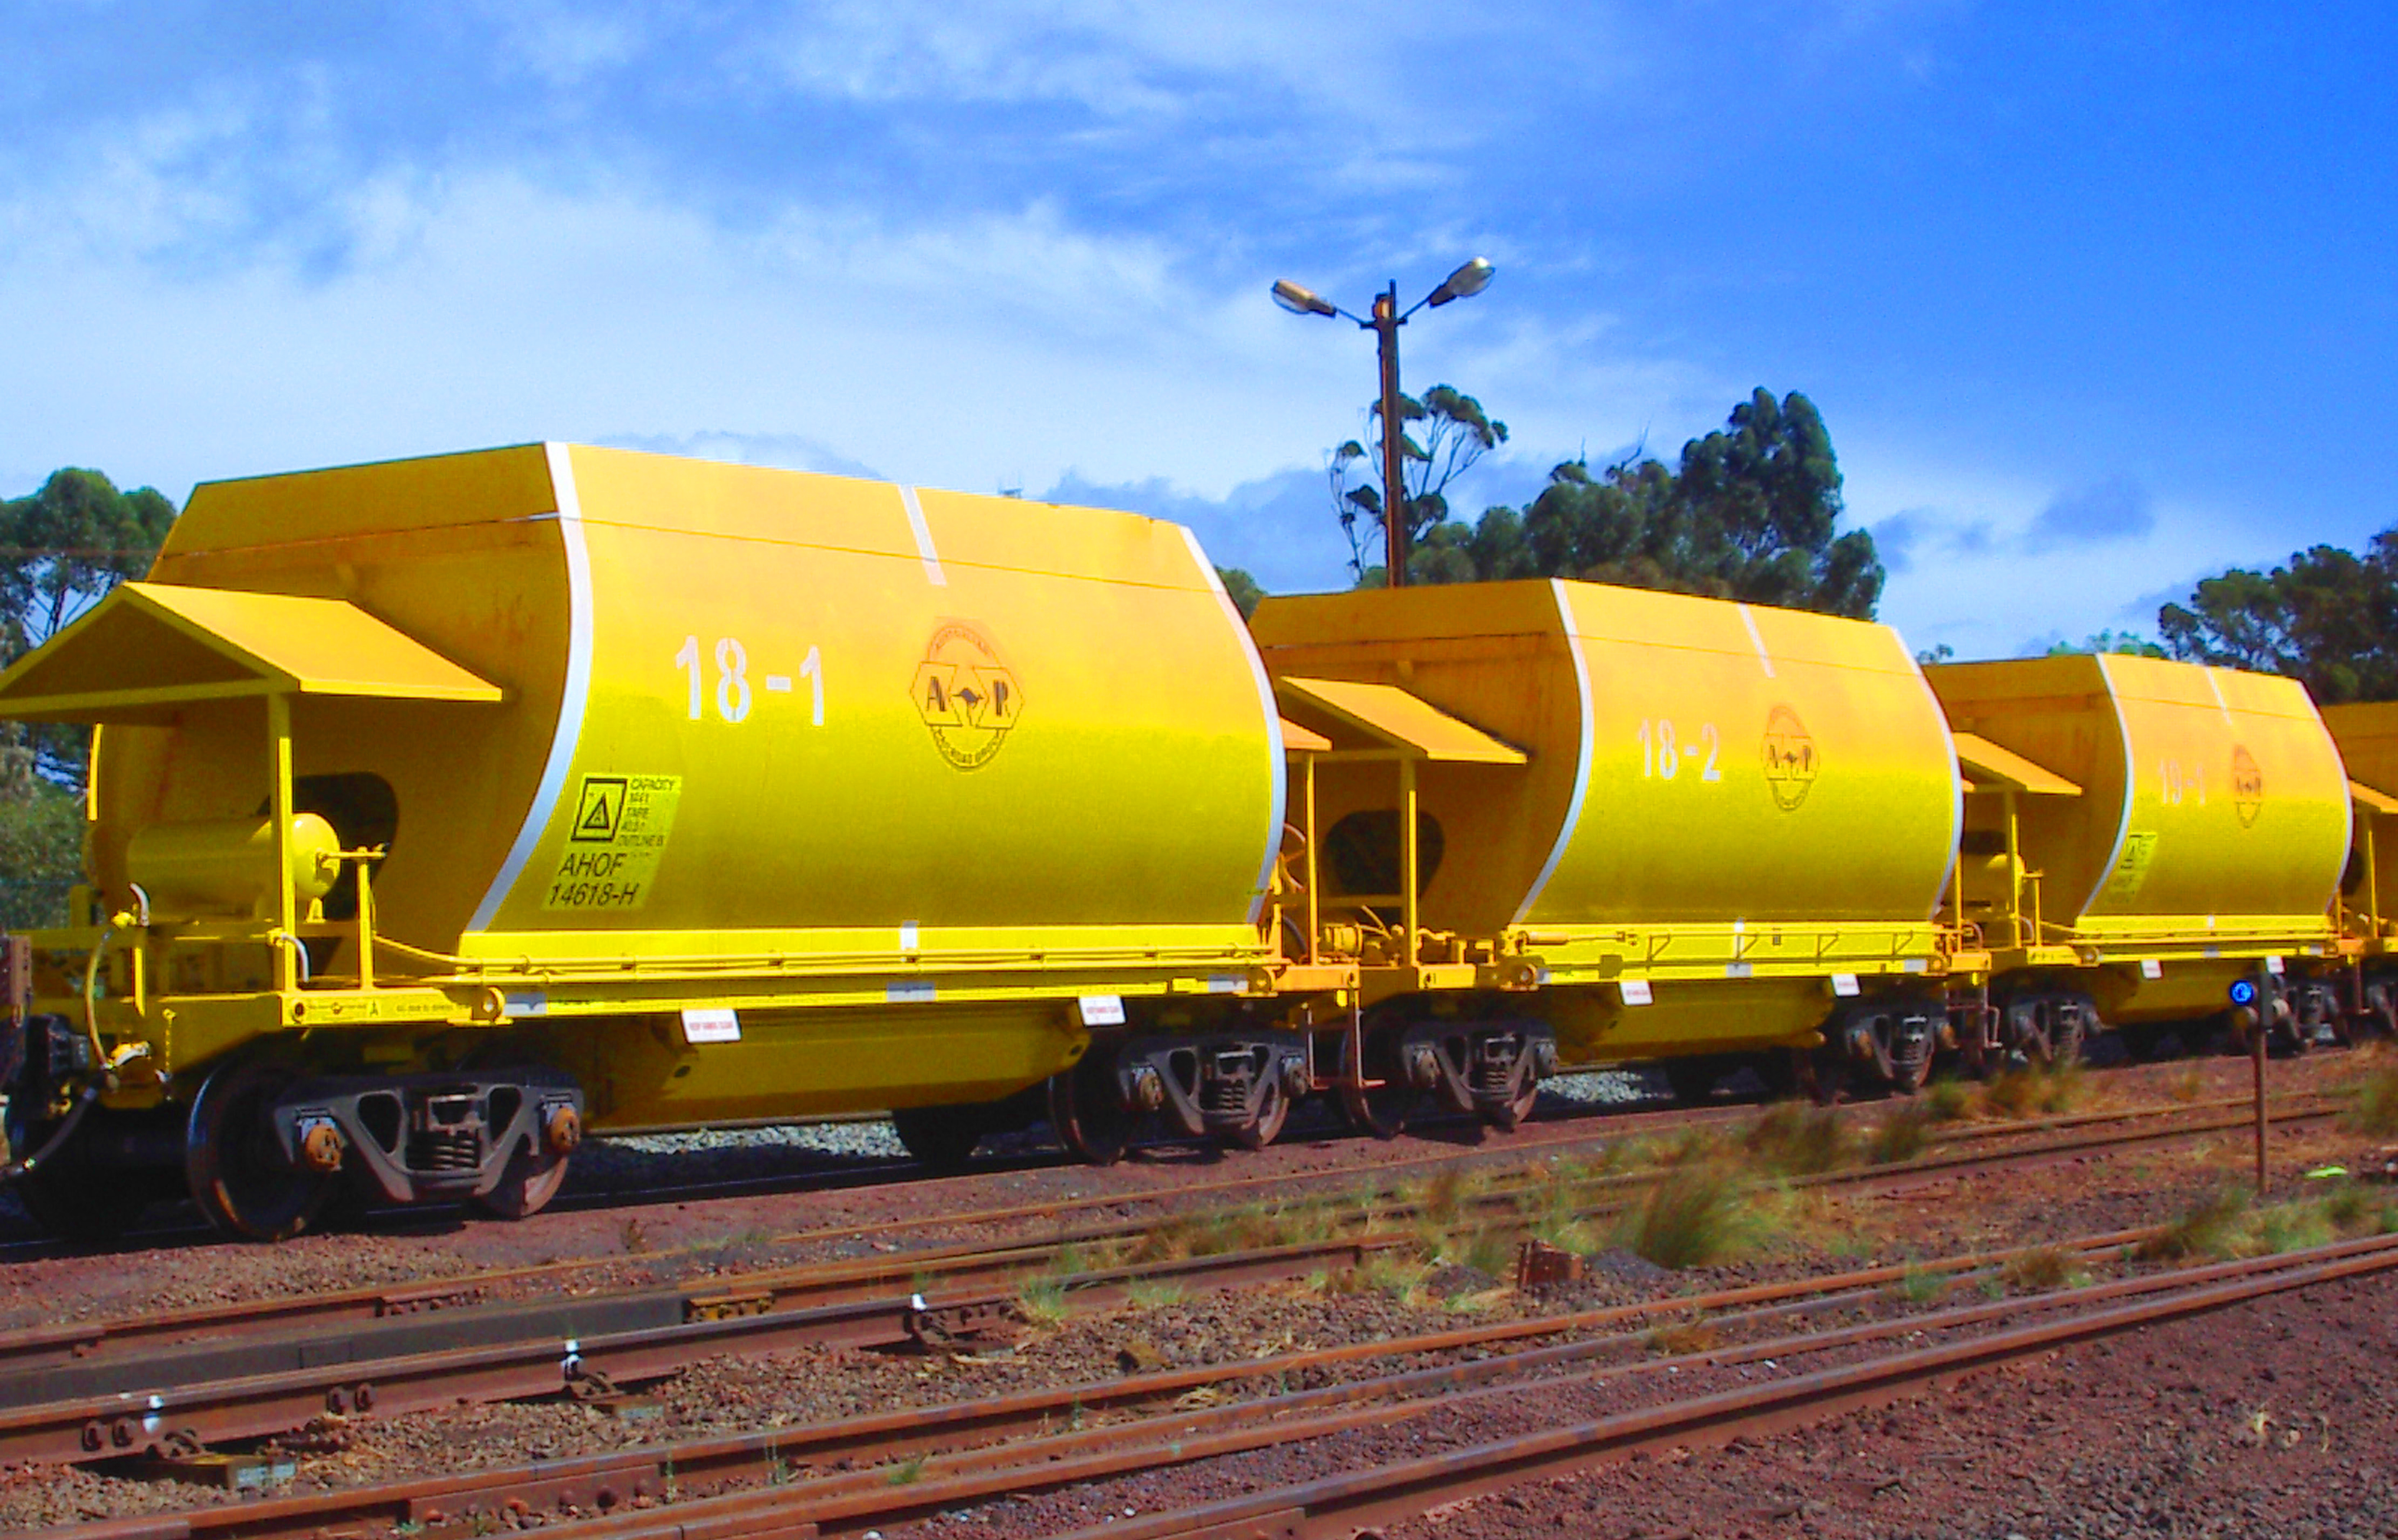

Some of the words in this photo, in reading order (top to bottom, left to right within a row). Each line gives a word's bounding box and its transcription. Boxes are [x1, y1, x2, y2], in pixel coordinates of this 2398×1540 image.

[675, 634, 824, 726] 18-1
[926, 676, 947, 712] A
[1637, 717, 1721, 781] 18-2
[558, 852, 627, 877] AHOF
[549, 883, 640, 906] 14618-H
